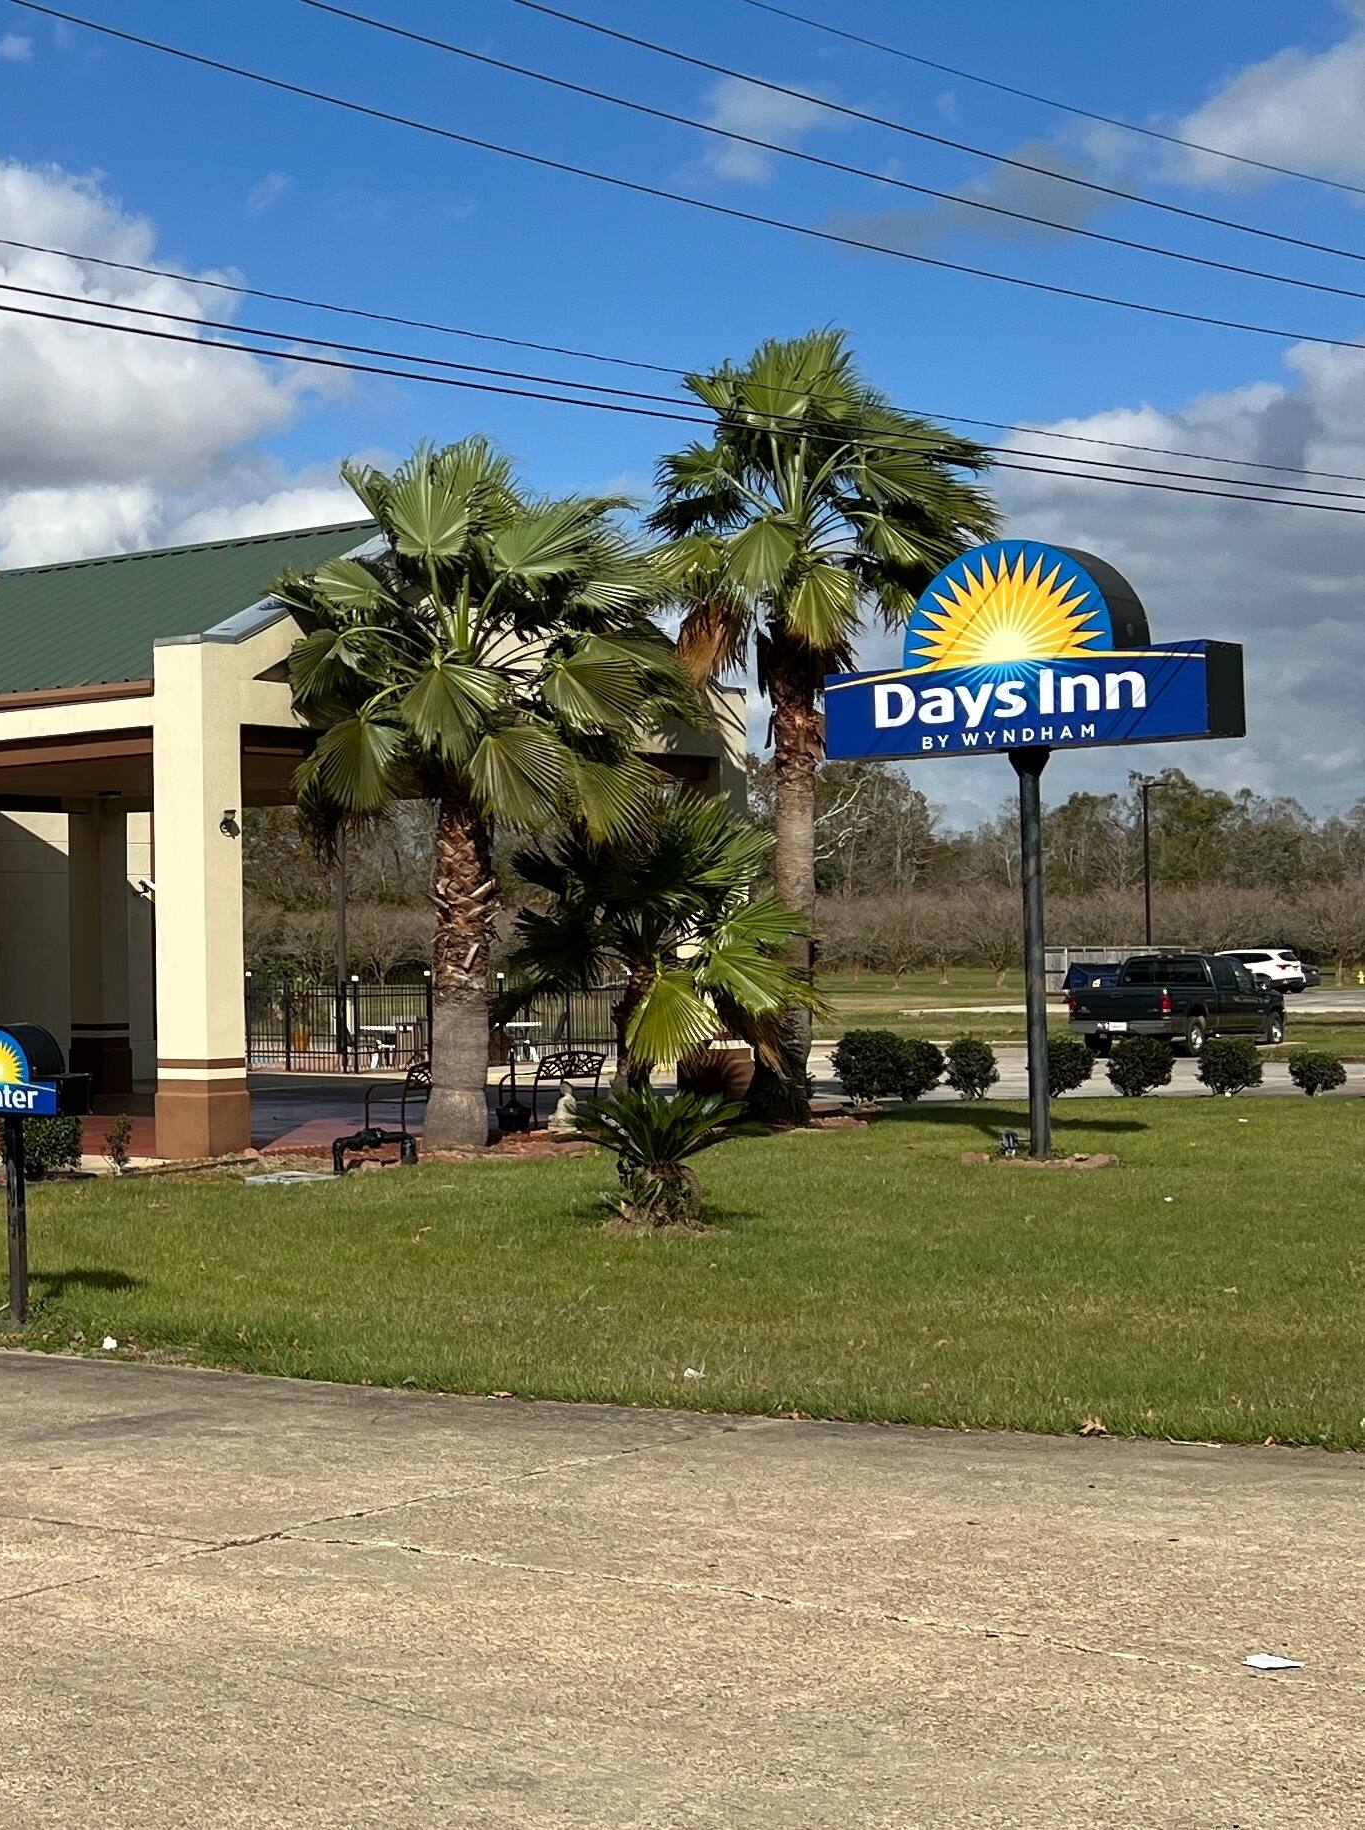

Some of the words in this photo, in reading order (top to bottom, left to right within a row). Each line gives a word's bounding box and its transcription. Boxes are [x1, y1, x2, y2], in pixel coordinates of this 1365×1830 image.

[874, 680, 1025, 728] Days
[1039, 669, 1146, 714] Inn
[921, 734, 949, 750] BY
[962, 723, 1096, 745] WYNDHAM
